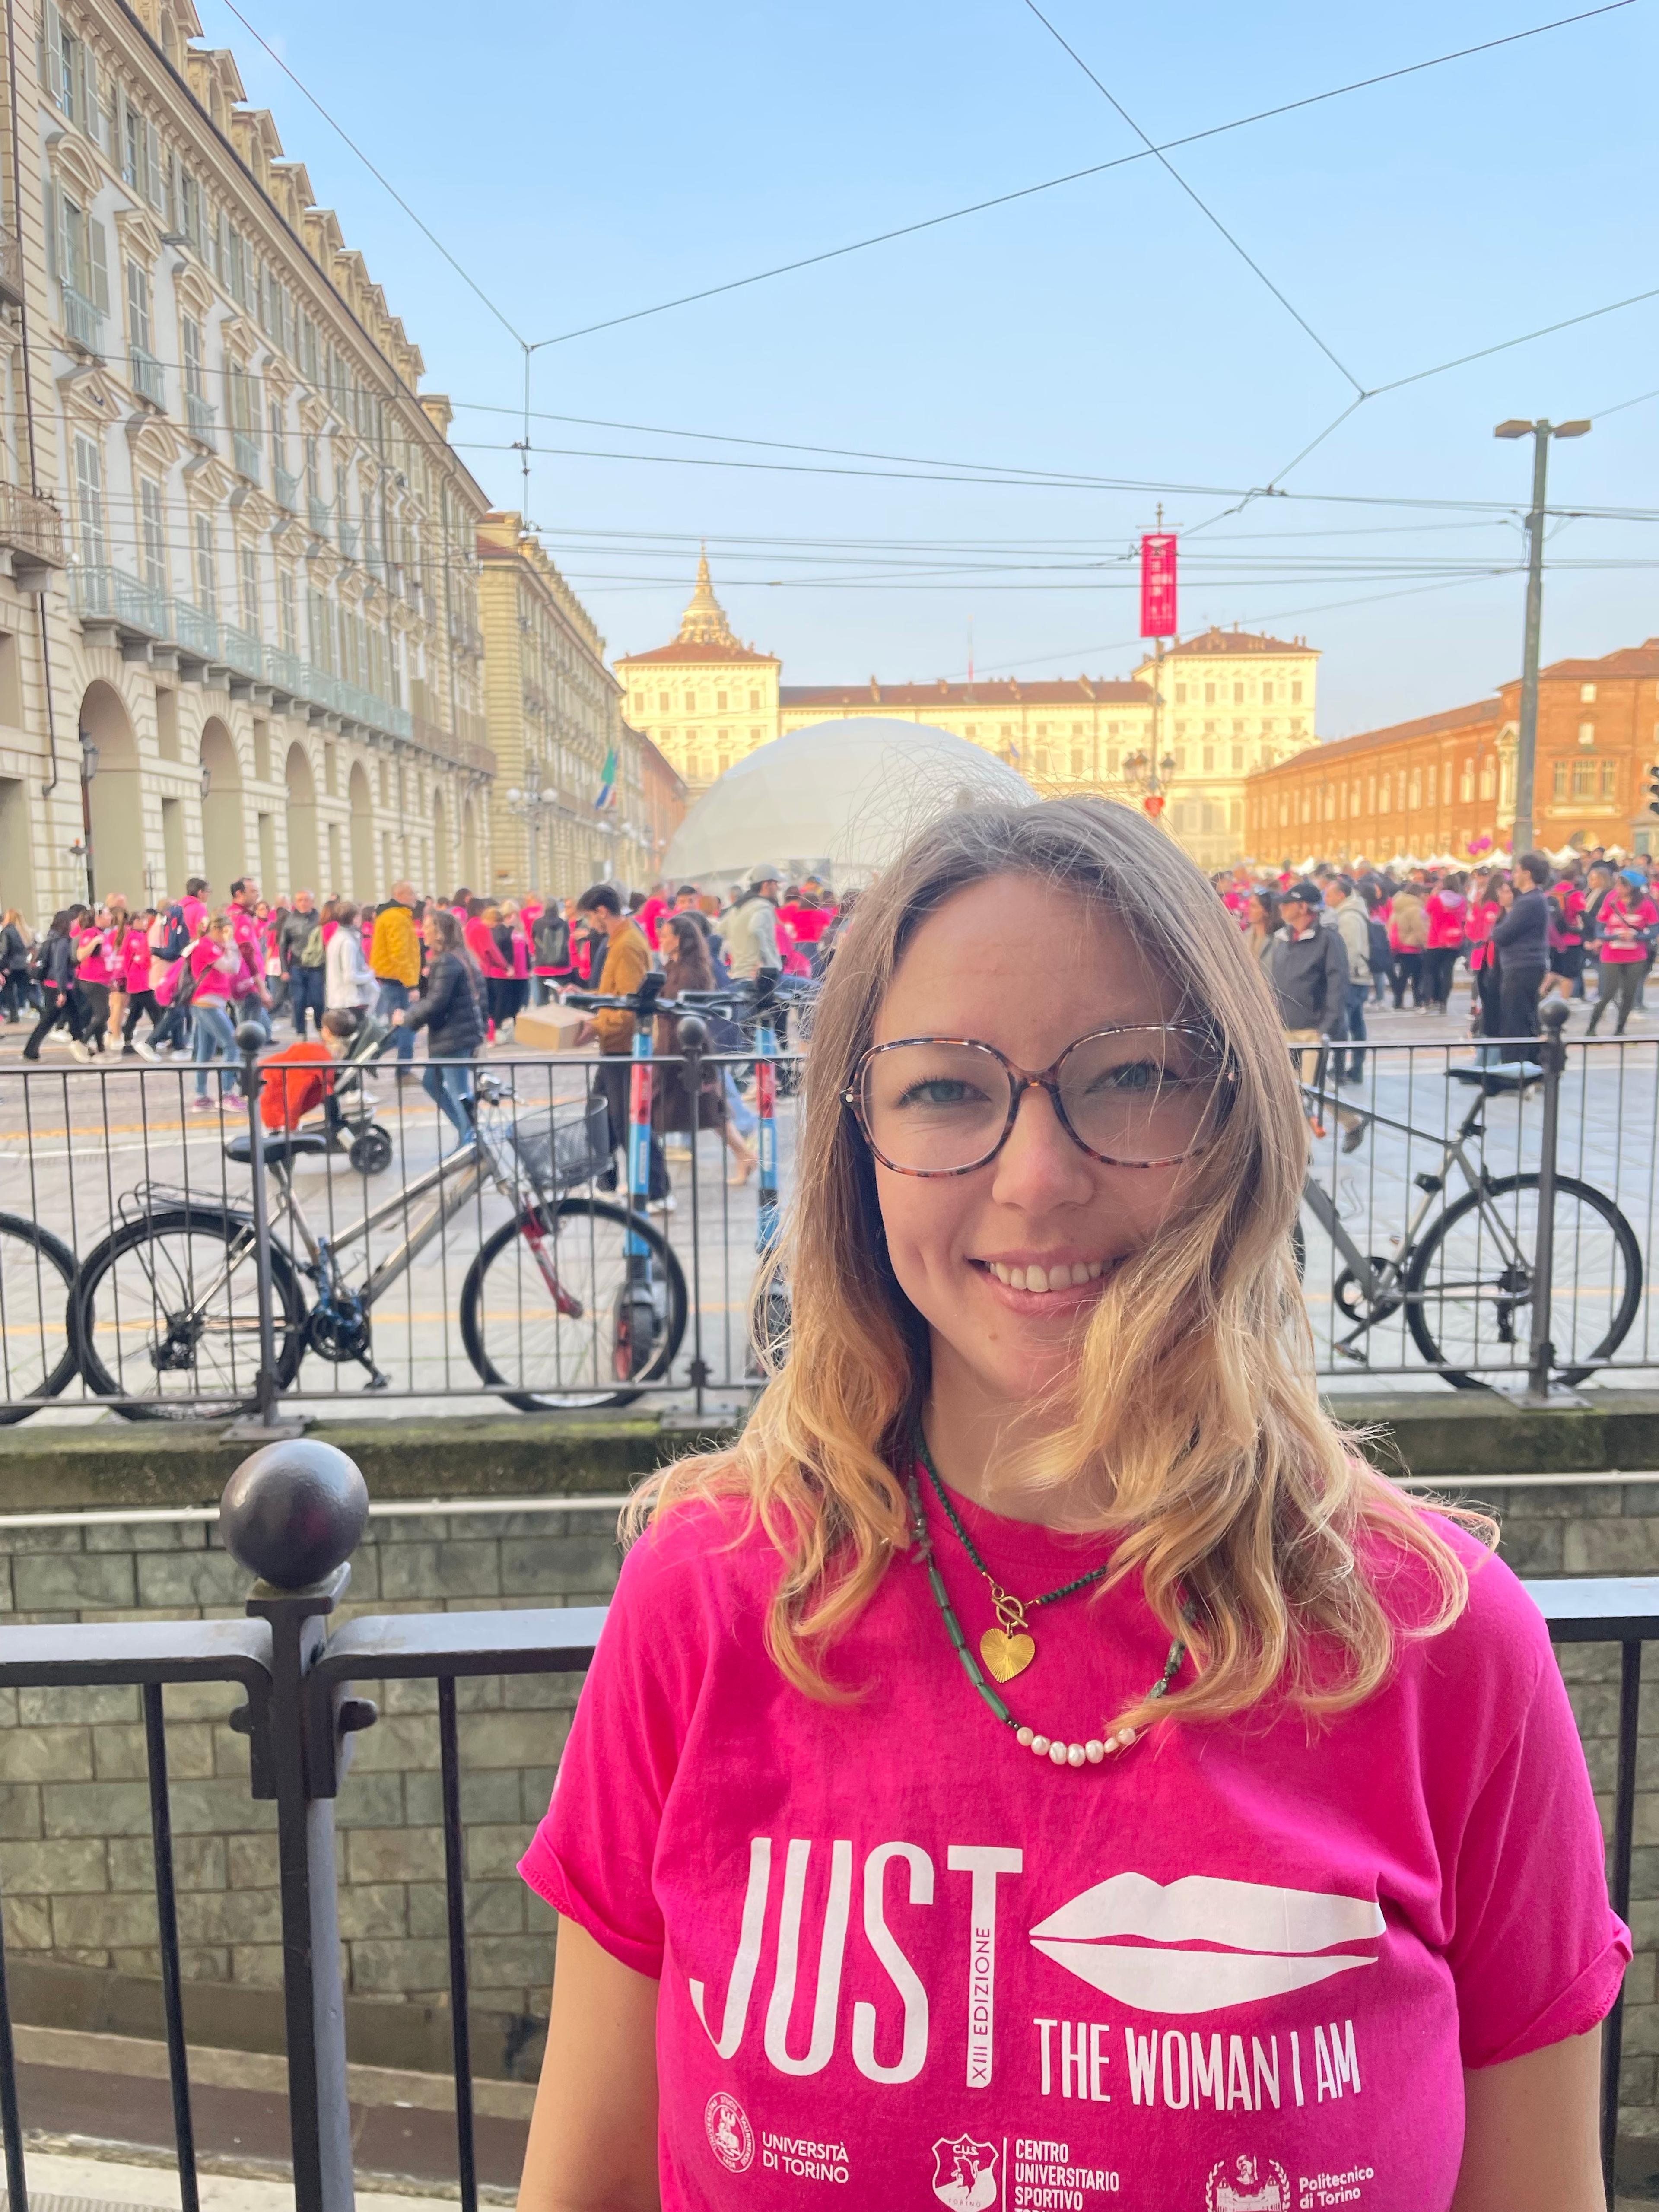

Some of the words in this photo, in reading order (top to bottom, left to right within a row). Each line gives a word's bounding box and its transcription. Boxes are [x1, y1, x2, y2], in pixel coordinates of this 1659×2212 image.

[689, 1837, 1023, 2088] JUST
[973, 1928, 990, 2035] EDIZIONE
[972, 2046, 988, 2080] XIII
[1033, 2018, 1111, 2102] THE
[1124, 2027, 1281, 2111] WOMAN
[1290, 2031, 1304, 2107] I
[1314, 2019, 1362, 2103] AM
[762, 2131, 849, 2163] UNIVERSITÀ
[1015, 2139, 1069, 2164] CENTRO
[763, 2150, 778, 2170] DI
[781, 2156, 849, 2183] TORINO
[1015, 2162, 1119, 2192] UNIVERSITARIO
[1299, 2166, 1374, 2193] Politecnico
[948, 2198, 981, 2208] TORINO
[1015, 2186, 1083, 2211] SPORTIVO
[1300, 2193, 1313, 2209] di
[1316, 2186, 1361, 2206] Torino
